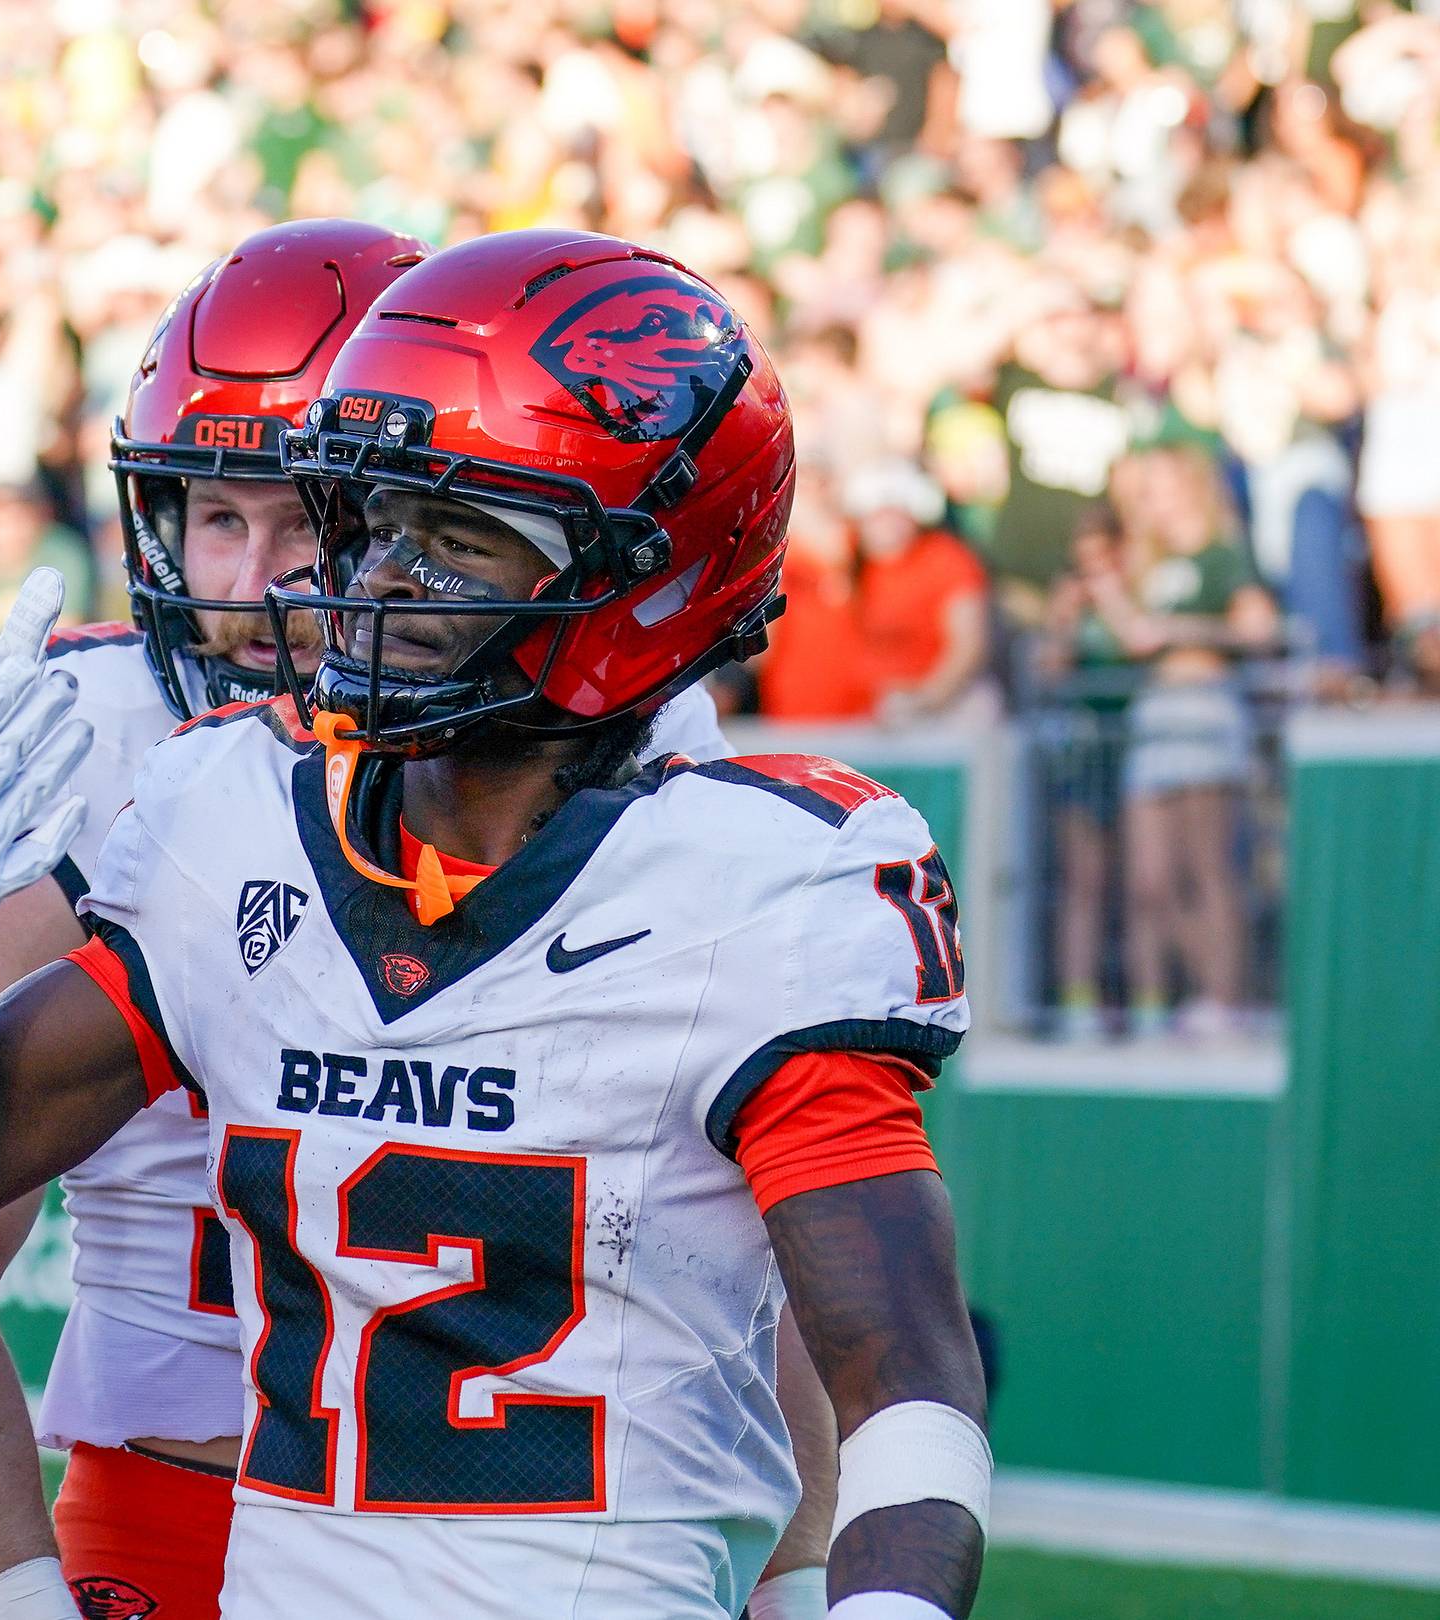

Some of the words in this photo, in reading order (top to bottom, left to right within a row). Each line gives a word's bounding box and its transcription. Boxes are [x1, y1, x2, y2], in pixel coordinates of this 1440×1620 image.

[339, 396, 383, 422] OSU
[195, 419, 264, 449] OSU
[410, 557, 463, 593] Kid!!
[230, 682, 276, 703] Ridd
[237, 880, 309, 942] PAC
[874, 844, 965, 1004] 12
[246, 940, 266, 960] 12
[277, 1048, 516, 1132] BEAVS
[217, 1123, 606, 1514] 12
